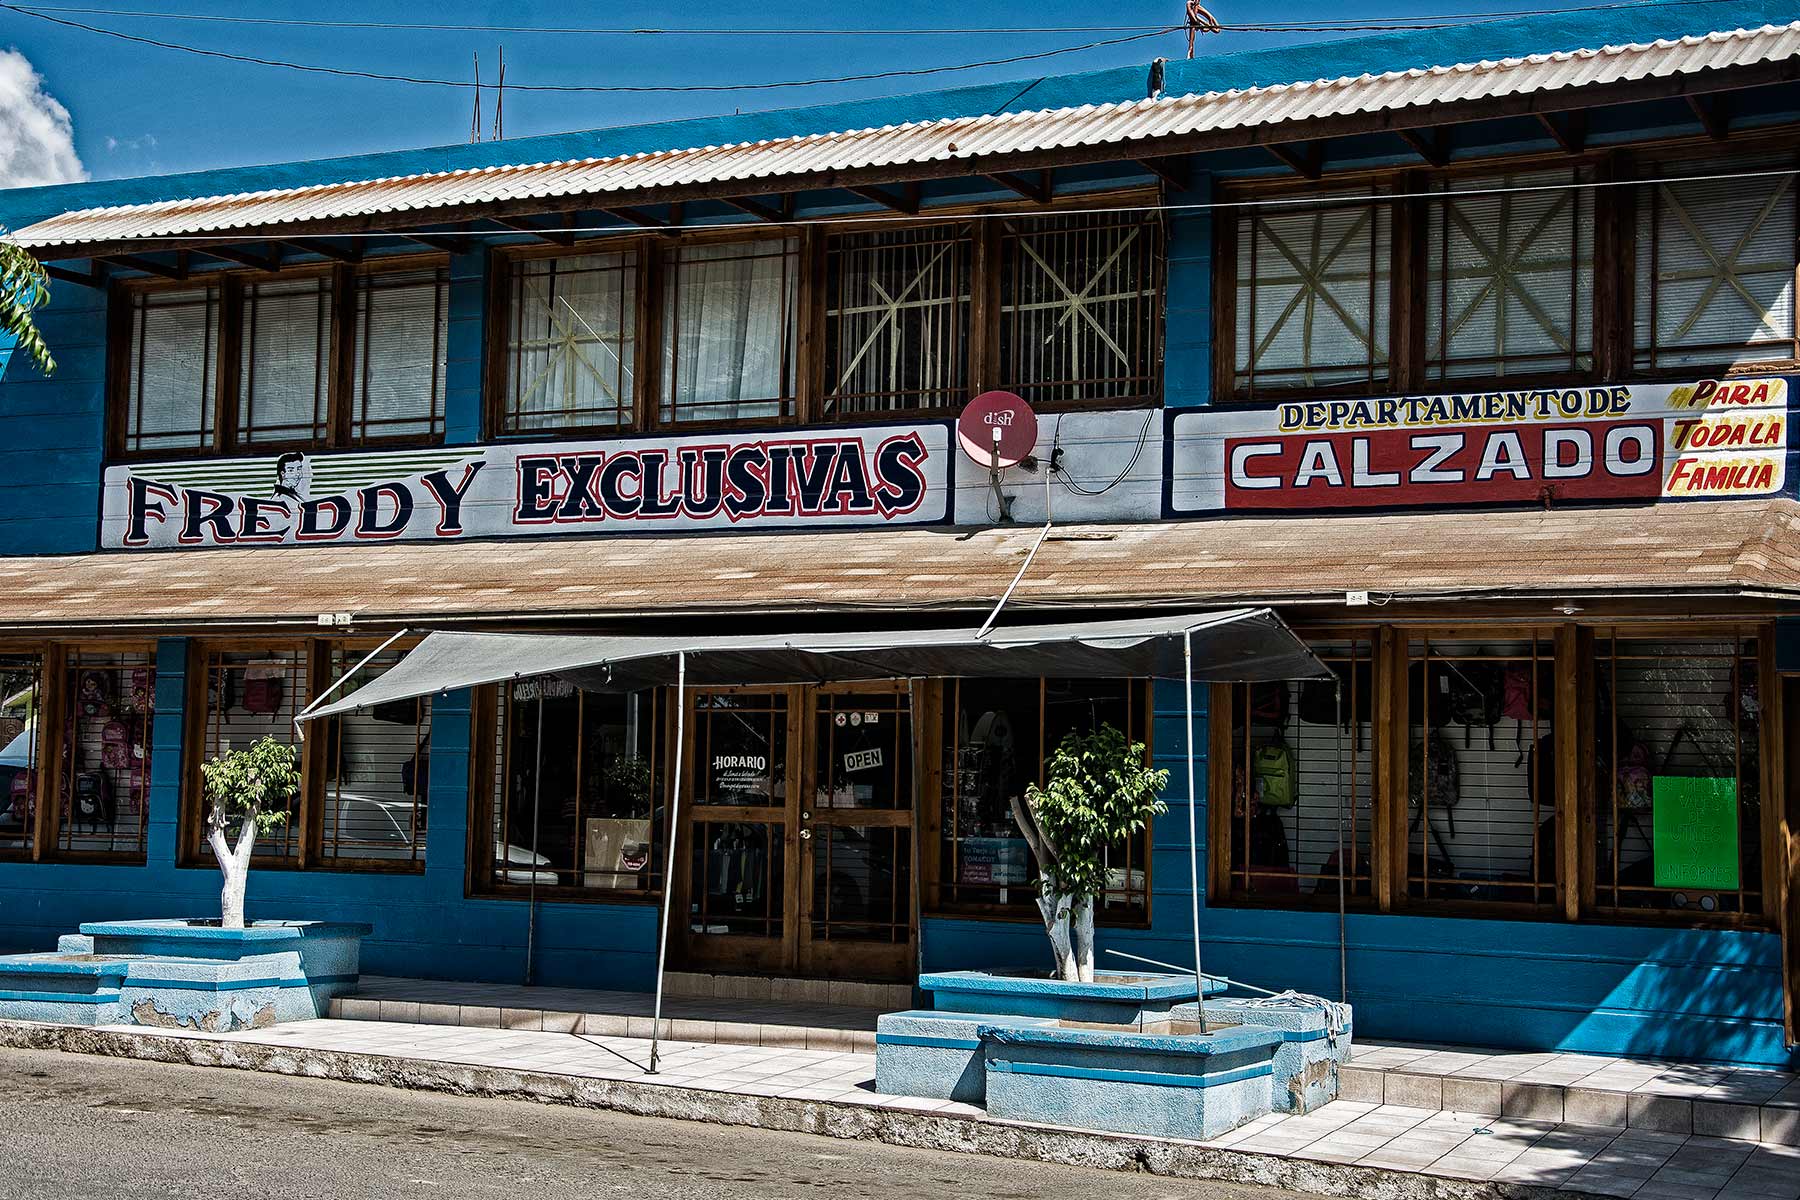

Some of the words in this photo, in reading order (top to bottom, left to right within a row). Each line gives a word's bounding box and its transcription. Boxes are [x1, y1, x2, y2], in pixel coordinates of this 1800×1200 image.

[1688, 380, 1769, 407] PARA
[984, 409, 1015, 426] dish
[1277, 389, 1582, 431] DEPARTAMENTO
[1587, 386, 1631, 418] DE
[1674, 419, 1747, 450] TODA
[1749, 422, 1781, 444] LA
[1230, 423, 1657, 490] CALZADO
[513, 430, 928, 525] EXCLUSIVAS
[1667, 457, 1774, 492] FAMILIA
[123, 460, 487, 546] FREDDY
[712, 755, 766, 770] HORARIO
[846, 750, 881, 769] OPEN
[1680, 793, 1721, 810] VALES
[1660, 864, 1733, 882] UNIFORMES
